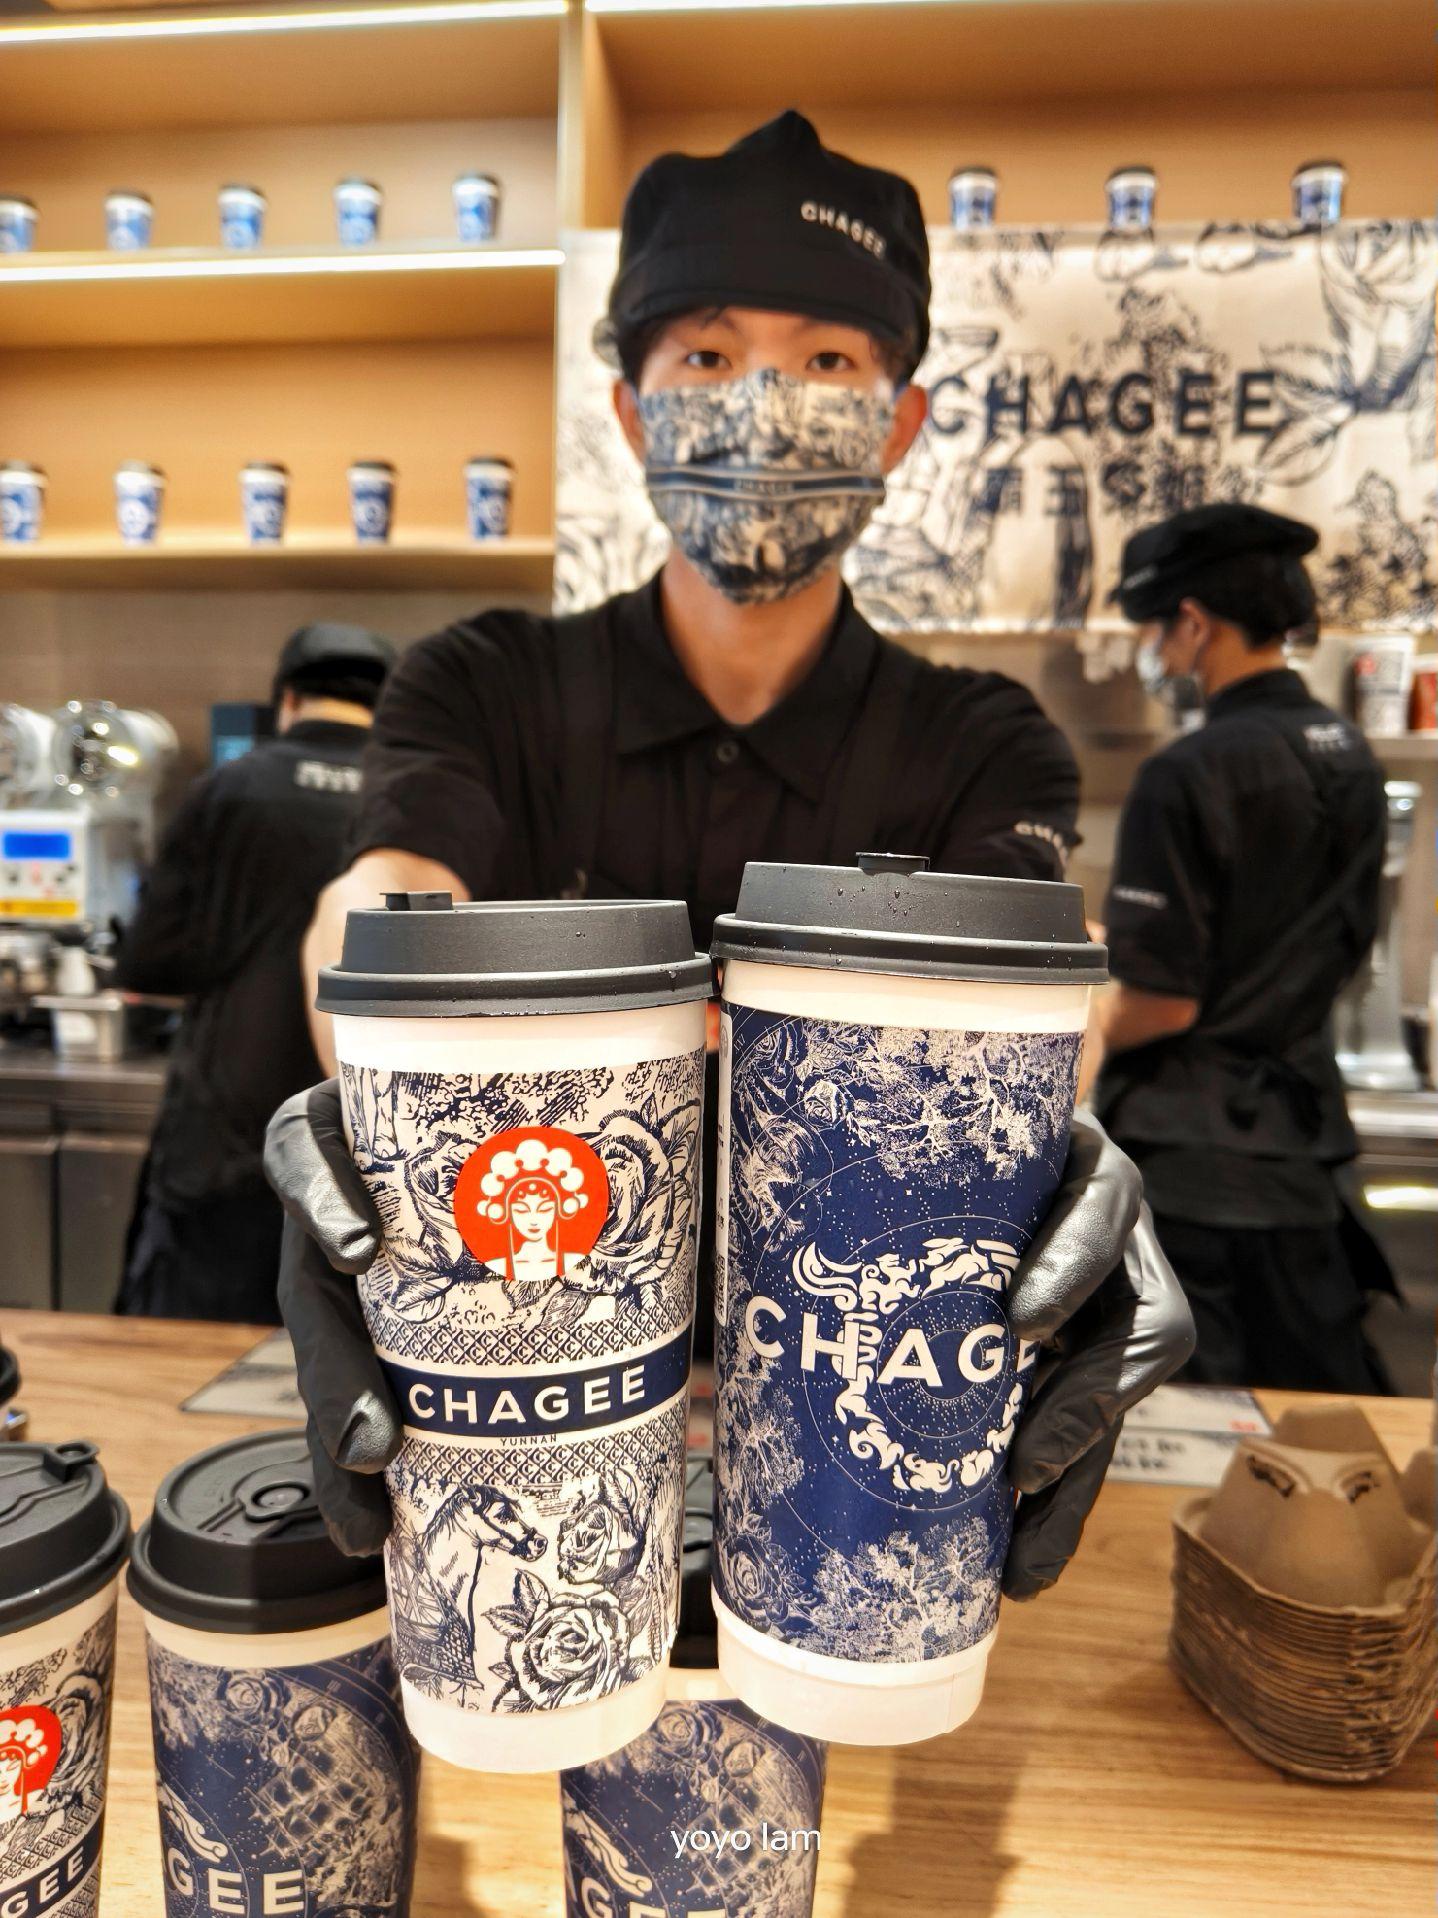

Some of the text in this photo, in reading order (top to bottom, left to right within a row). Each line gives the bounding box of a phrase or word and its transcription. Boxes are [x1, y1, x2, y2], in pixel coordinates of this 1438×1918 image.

[929, 372, 1276, 437] CHAGEE
[408, 1364, 645, 1424] CHAGEE
[500, 1434, 558, 1447] YUNNAN
